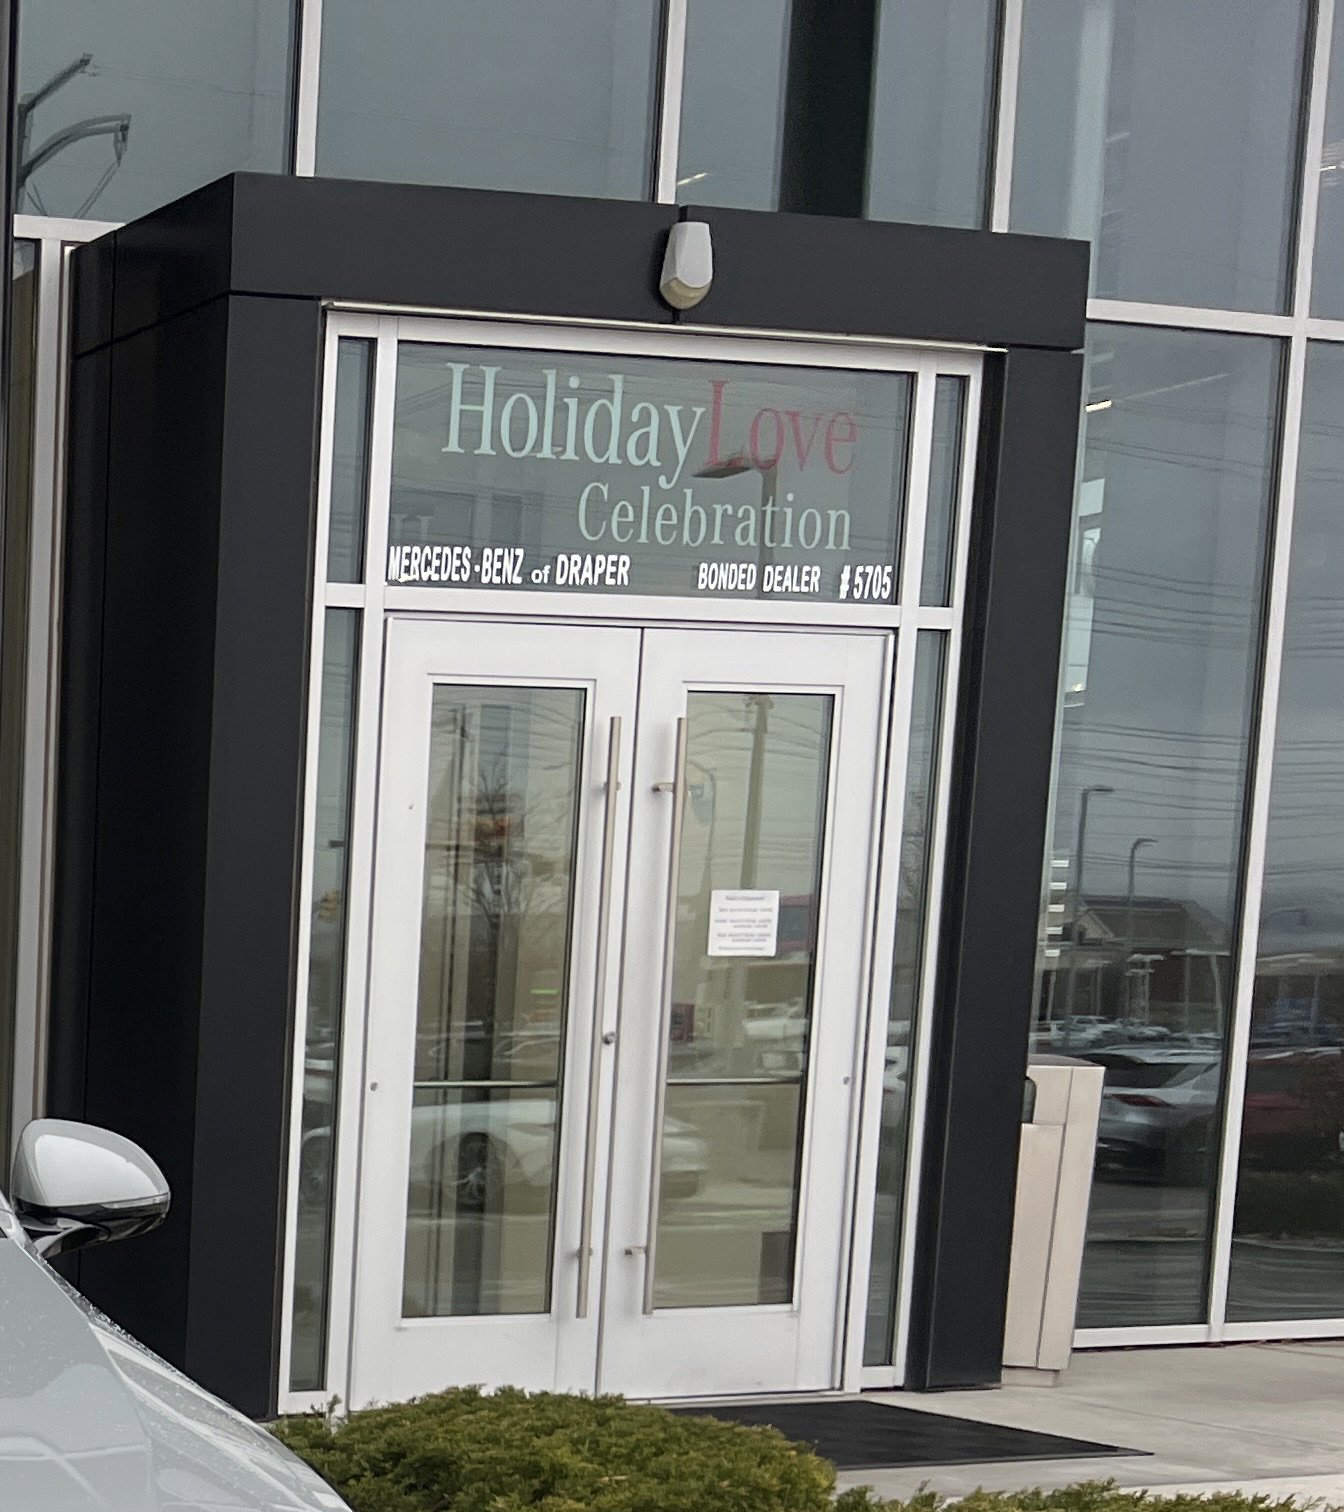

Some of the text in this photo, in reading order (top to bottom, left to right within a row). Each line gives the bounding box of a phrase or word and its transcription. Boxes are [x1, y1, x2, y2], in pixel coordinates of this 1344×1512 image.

[441, 362, 859, 489] Holiday Love
[578, 481, 853, 551] Celebration
[531, 565, 552, 584] of
[555, 554, 631, 586] DRAPER
[697, 562, 757, 591] BONDED
[762, 565, 822, 593] DEALER
